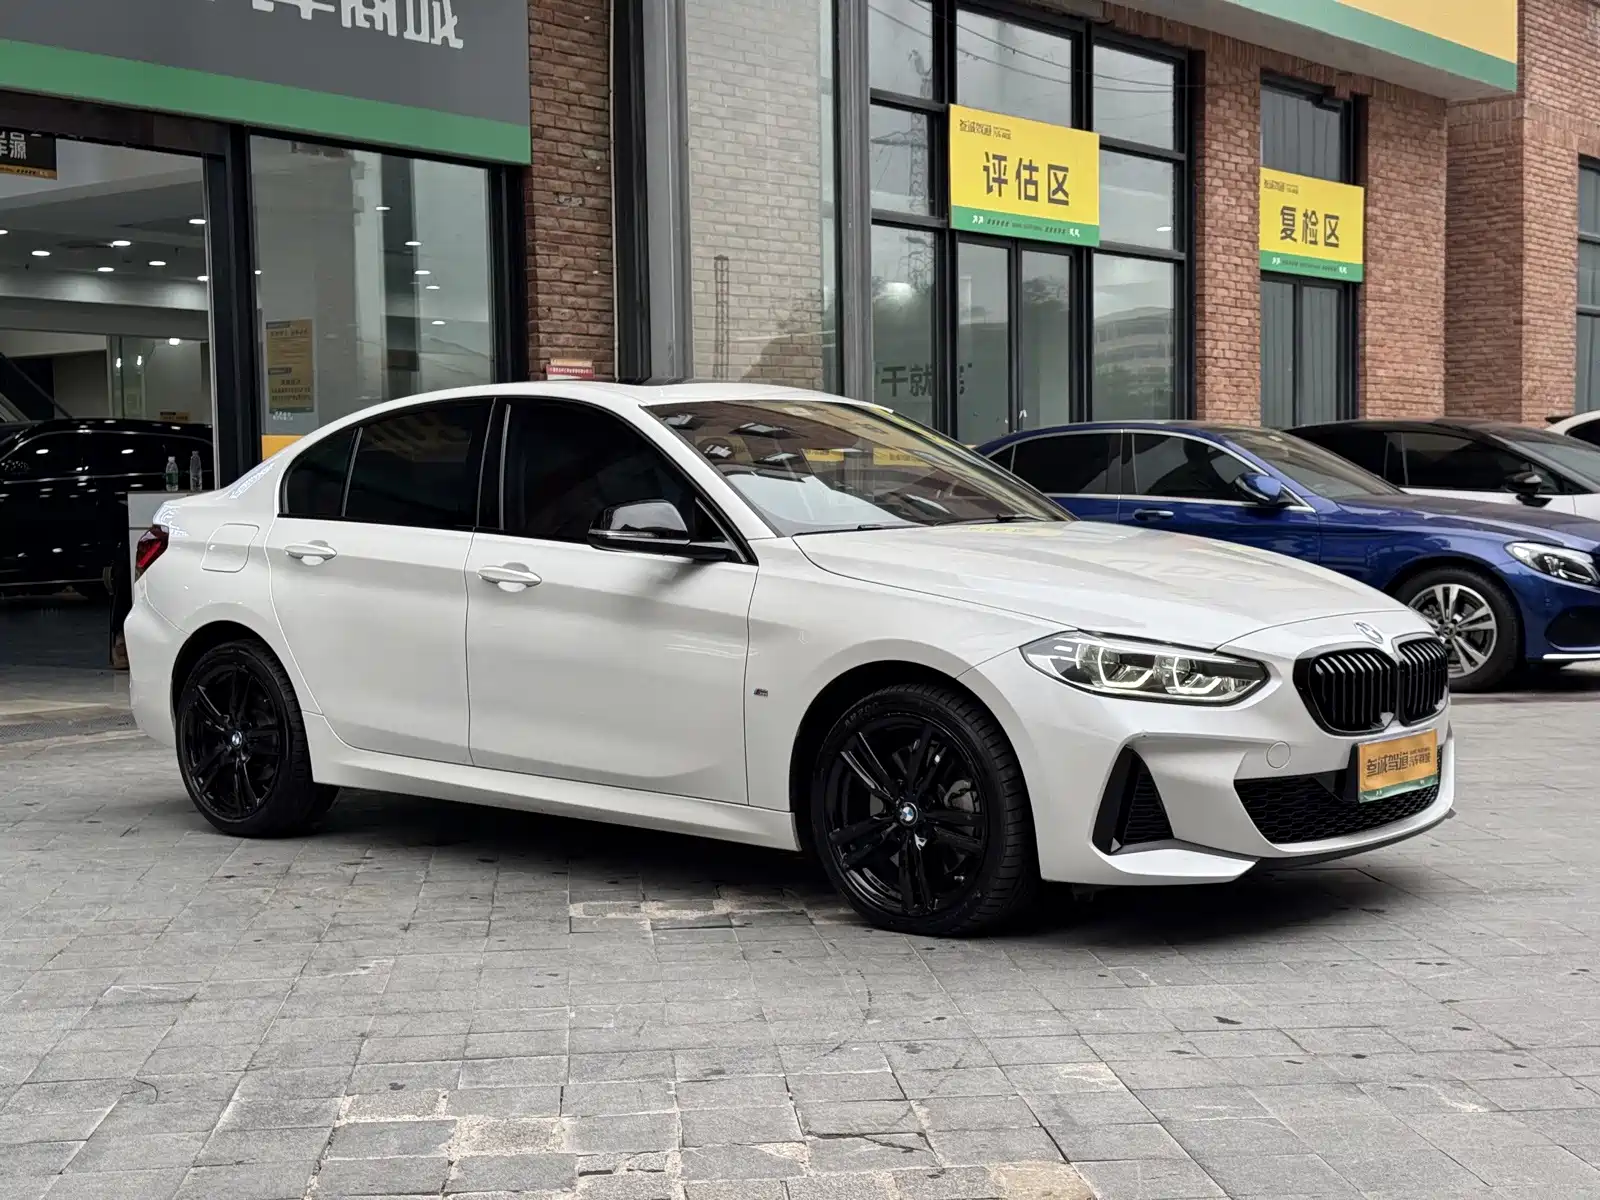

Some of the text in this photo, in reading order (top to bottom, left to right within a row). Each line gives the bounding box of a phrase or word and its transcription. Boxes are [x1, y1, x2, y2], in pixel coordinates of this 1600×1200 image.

[983, 151, 1070, 206] 评估区
[1280, 206, 1340, 248] 复检区
